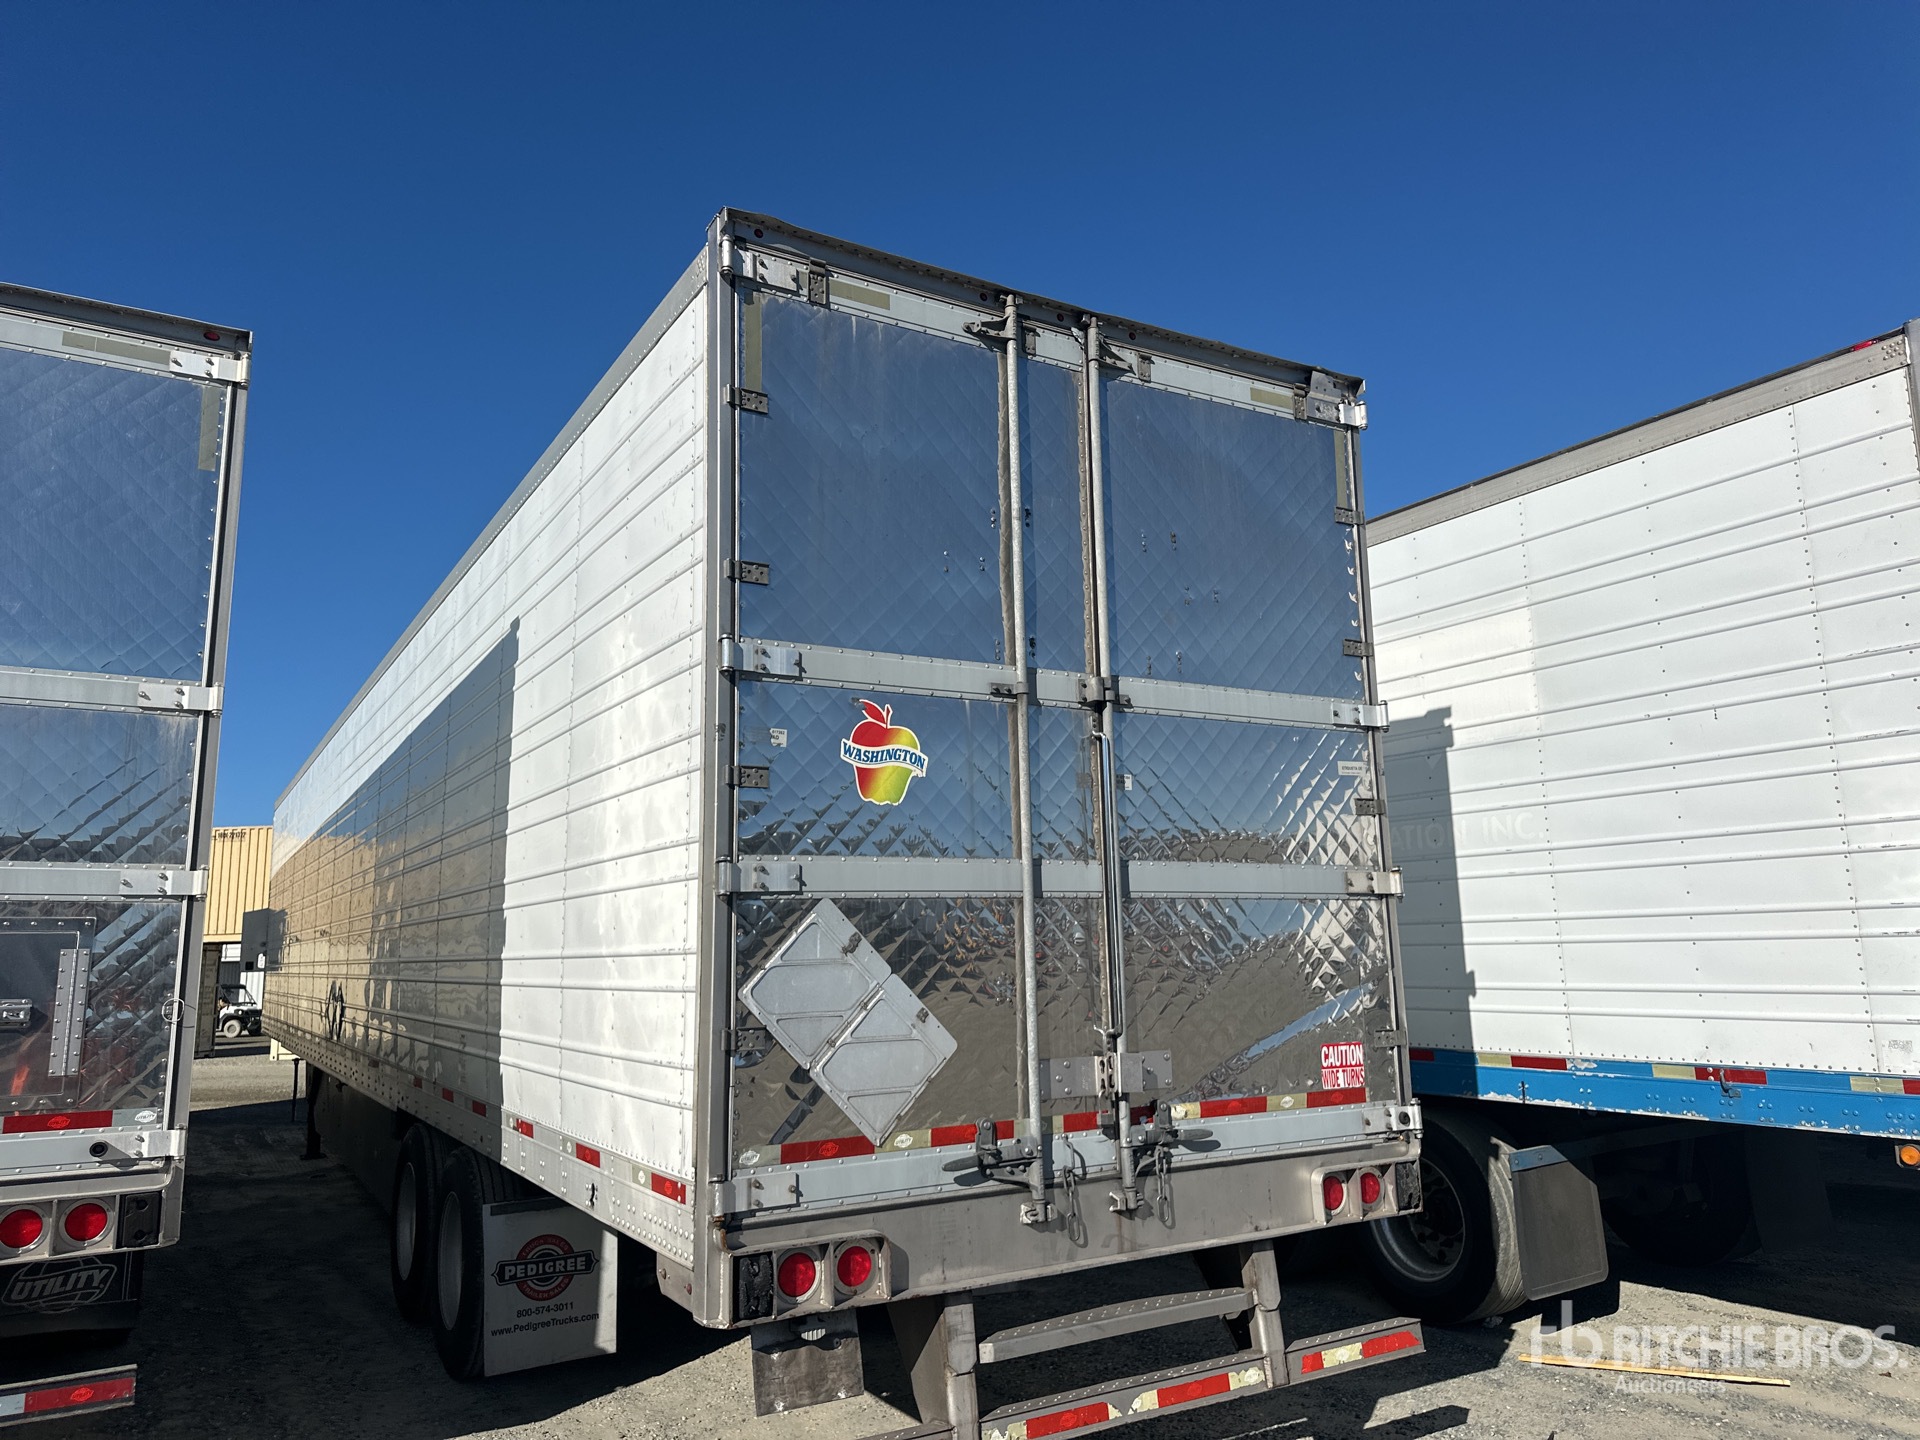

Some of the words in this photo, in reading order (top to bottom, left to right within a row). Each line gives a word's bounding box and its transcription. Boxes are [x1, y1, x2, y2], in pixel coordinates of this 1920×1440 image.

[842, 741, 926, 770] WASHINGTON
[1482, 812, 1545, 845] INC.
[1321, 1044, 1363, 1067] CAUTION
[1322, 1069, 1340, 1088] WIDE
[1341, 1068, 1365, 1087] TURNS
[504, 1257, 586, 1280] PEDIGREE
[11, 1269, 109, 1299] UTILITY
[516, 1302, 574, 1318] 800-574-3011
[491, 1313, 599, 1336] www.PedigreeTrucks.com
